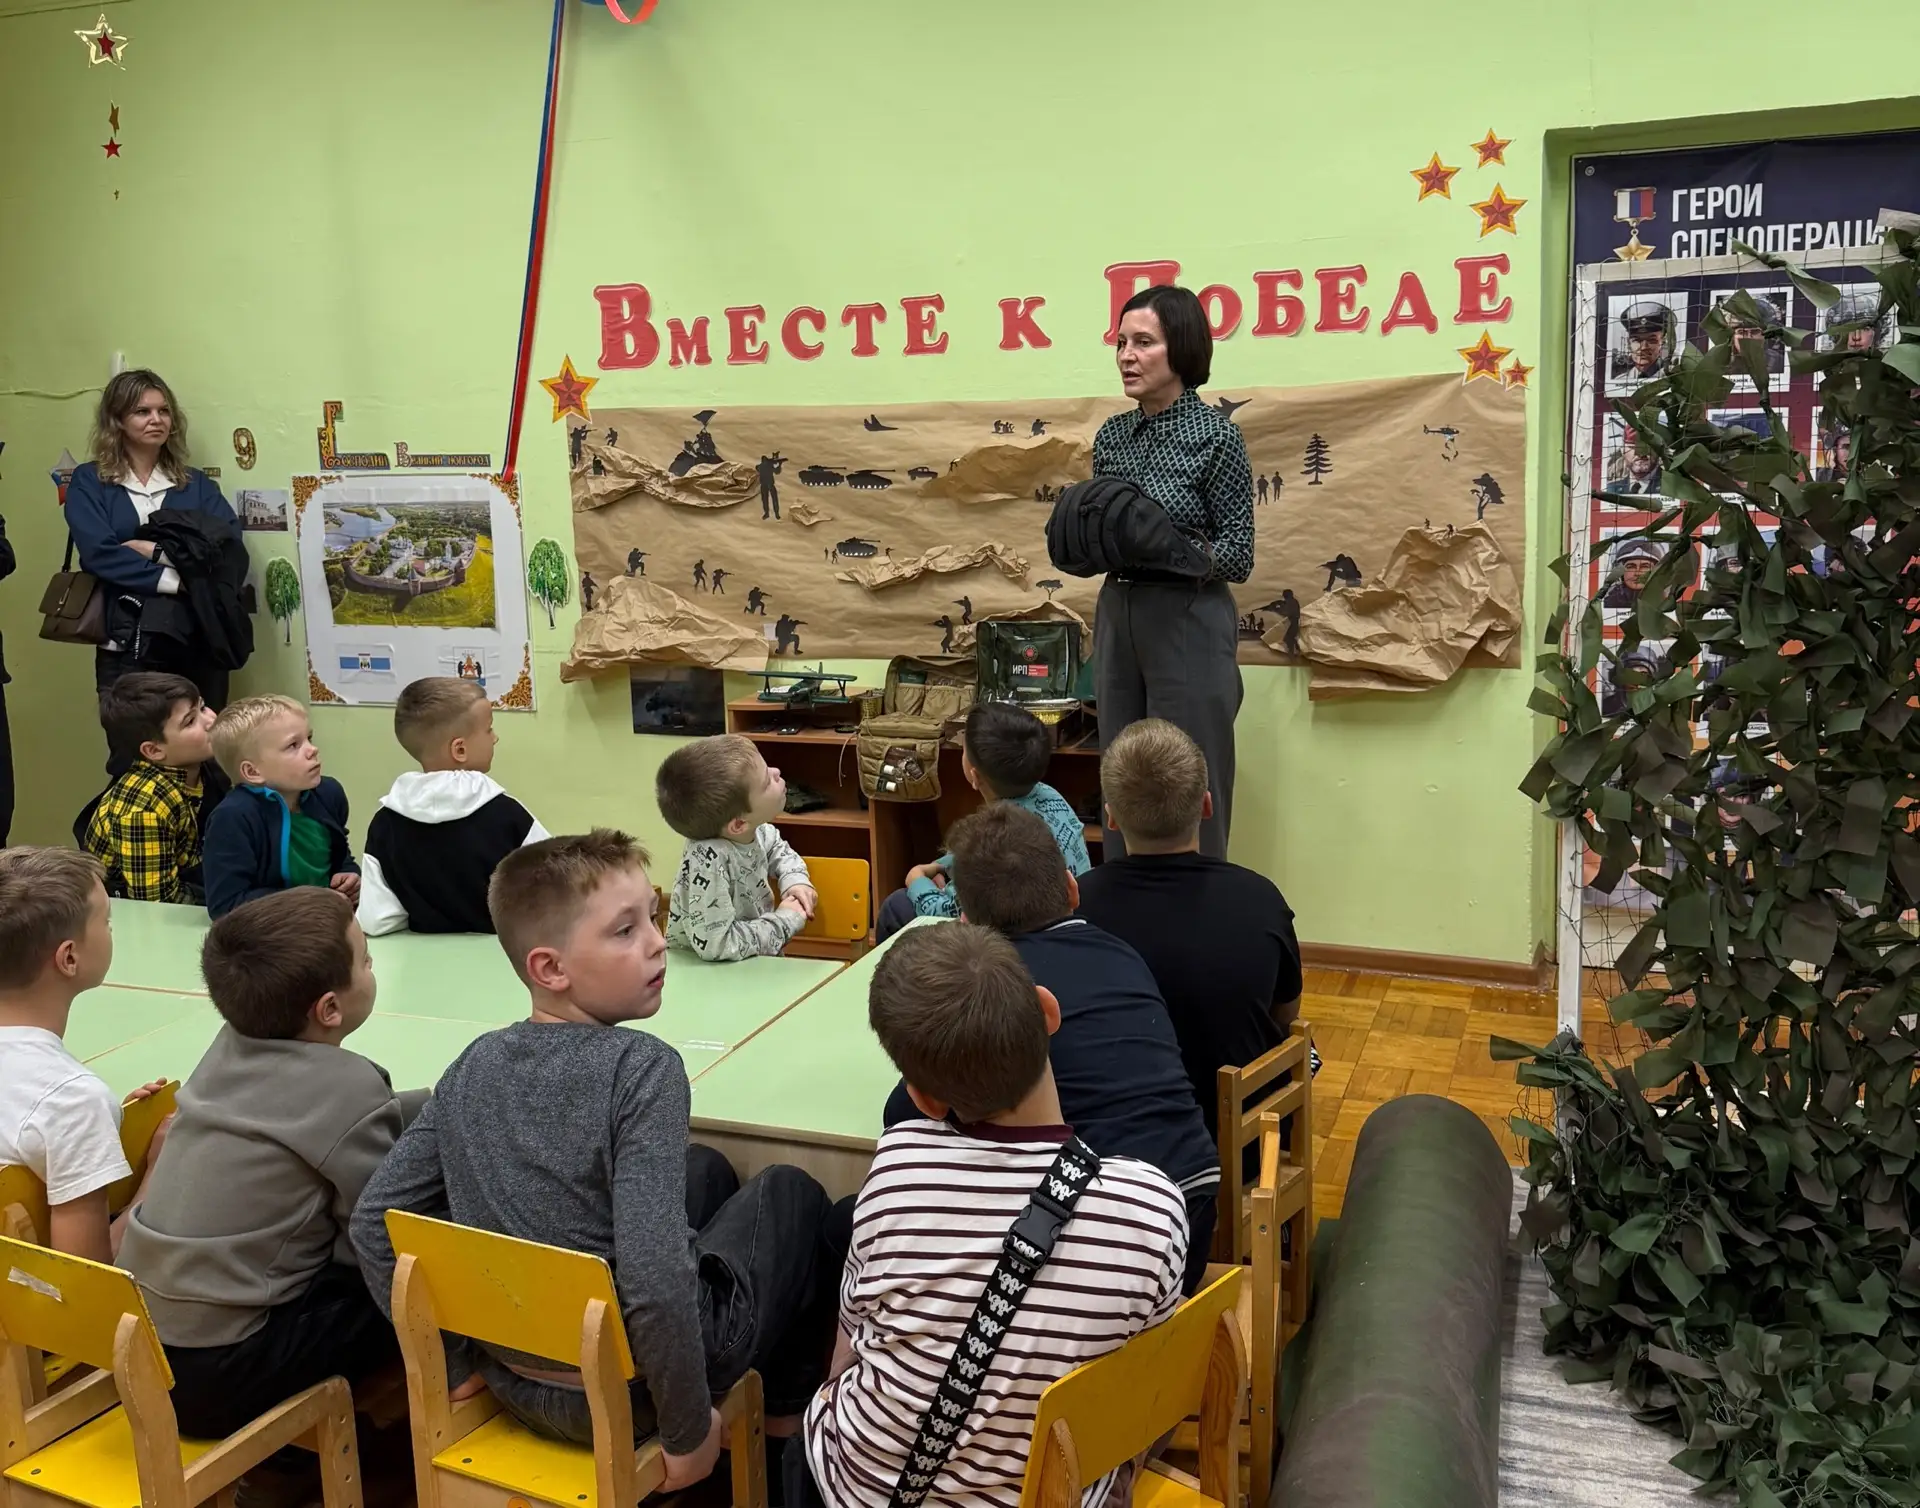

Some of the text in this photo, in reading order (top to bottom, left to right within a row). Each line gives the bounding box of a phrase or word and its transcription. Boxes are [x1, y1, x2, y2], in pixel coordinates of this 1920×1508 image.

[1672, 183, 1763, 222] ГЕРОИ
[1671, 219, 1886, 258] СПЕЦОПЕРАЦИ
[593, 283, 949, 370] ВМЕСТЕ
[233, 428, 257, 470] 9
[1012, 664, 1028, 675] ИРП
